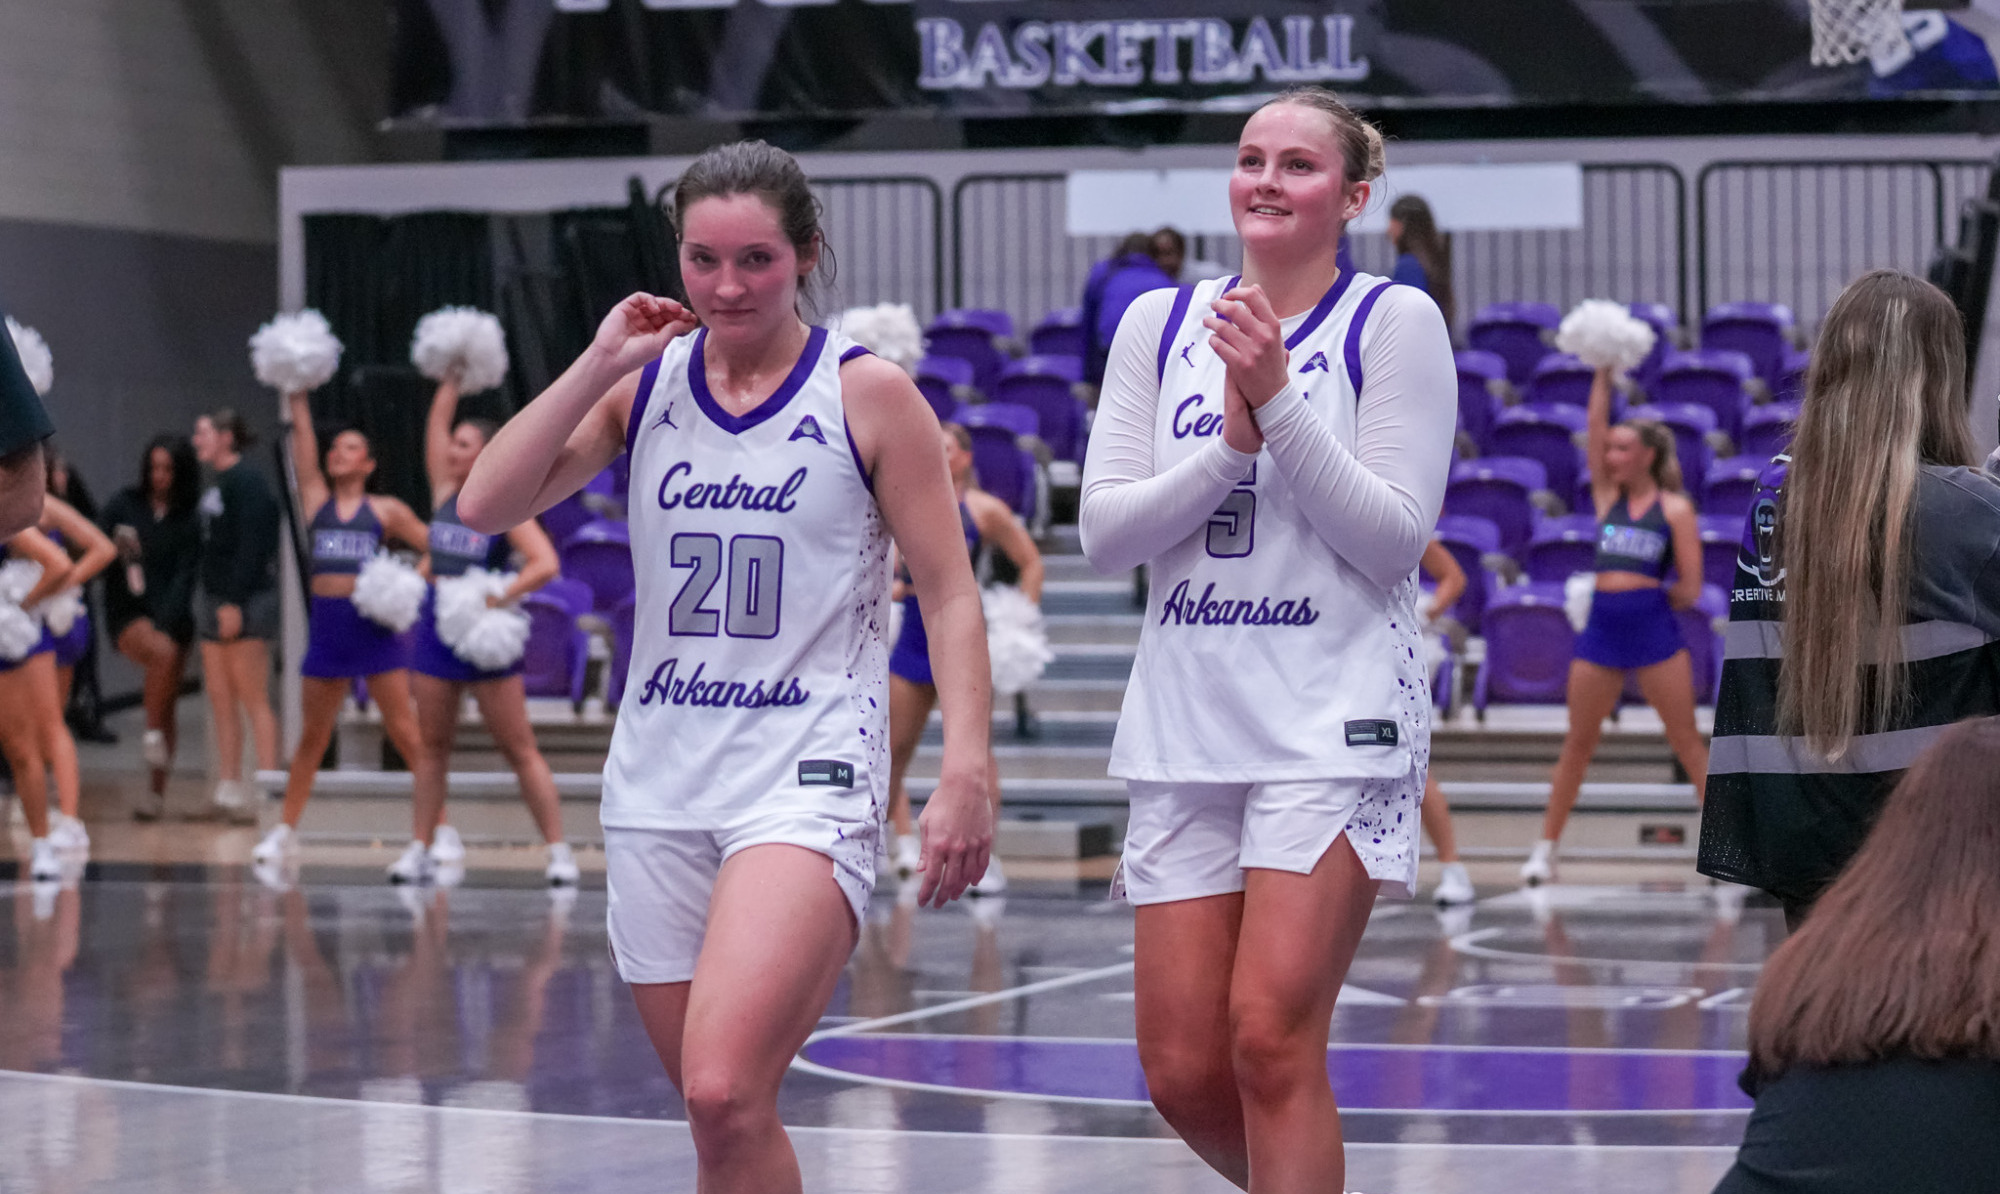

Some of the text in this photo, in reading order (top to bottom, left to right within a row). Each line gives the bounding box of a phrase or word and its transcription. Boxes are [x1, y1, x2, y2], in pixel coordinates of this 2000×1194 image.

[916, 15, 1369, 88] BASKETBALL
[658, 461, 808, 513] Central
[668, 532, 785, 640] 20
[1160, 579, 1320, 626] Arkansas
[1381, 726, 1394, 738] XL
[837, 768, 848, 779] M
